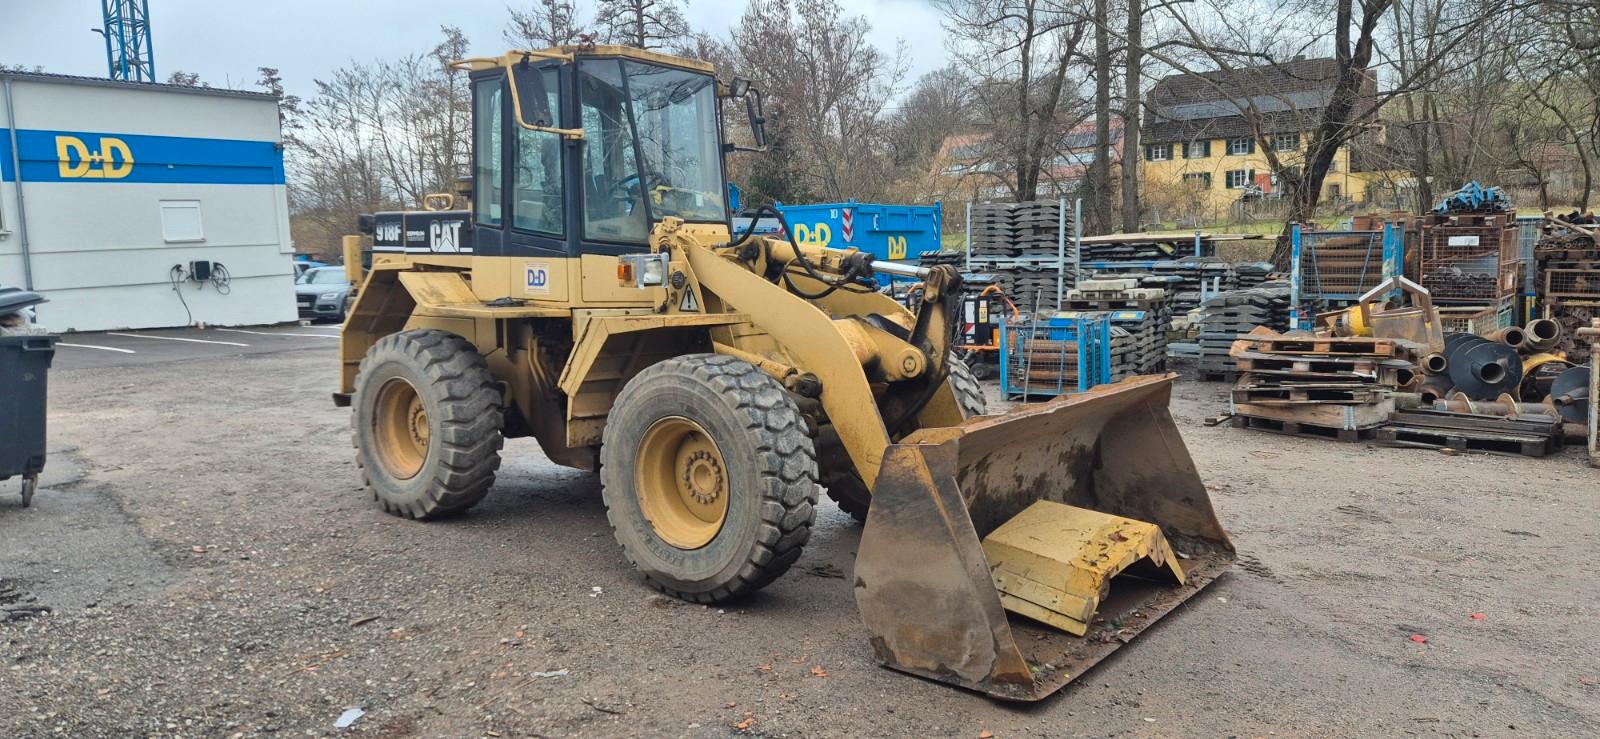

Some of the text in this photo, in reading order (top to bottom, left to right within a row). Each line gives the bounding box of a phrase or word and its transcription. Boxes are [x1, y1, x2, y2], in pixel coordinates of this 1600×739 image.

[55, 136, 134, 178] D+D
[376, 223, 402, 241] 918F
[430, 221, 464, 252] CAT
